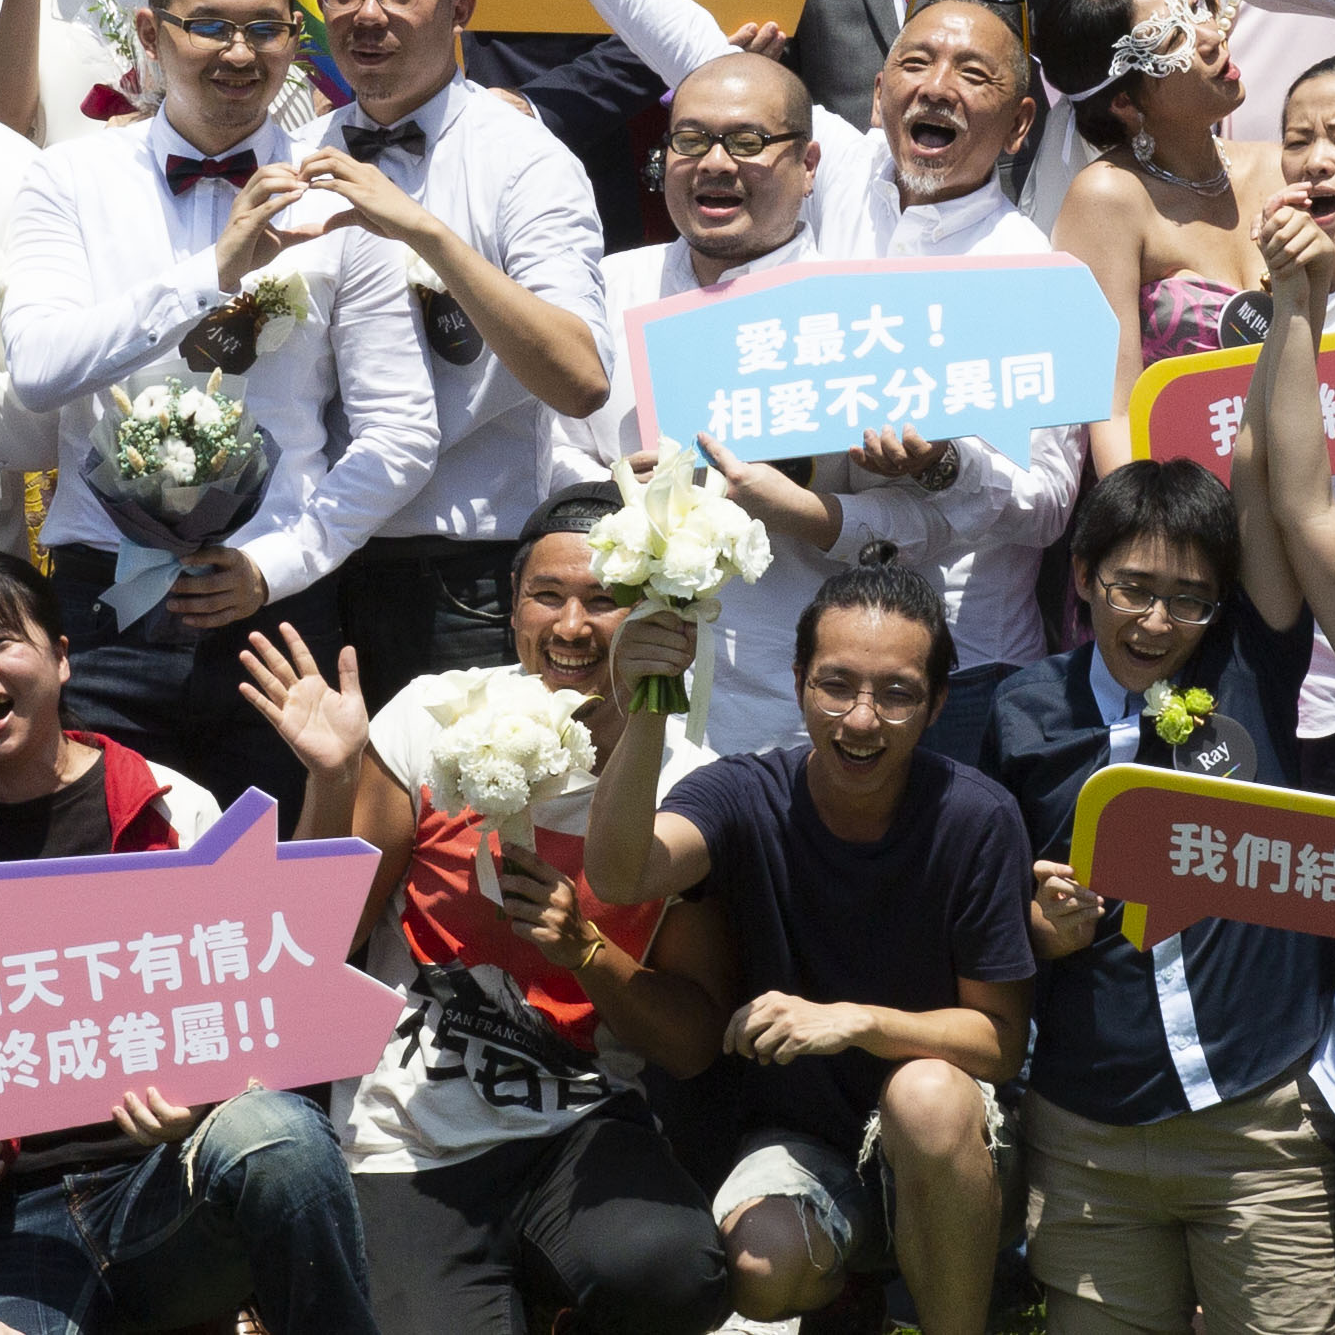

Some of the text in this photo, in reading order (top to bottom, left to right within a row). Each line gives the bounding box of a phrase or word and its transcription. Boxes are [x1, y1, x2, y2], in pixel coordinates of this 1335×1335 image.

[735, 303, 947, 375] 愛最大！
[707, 351, 1056, 442] 相愛不分異同
[1197, 741, 1230, 771] Ray
[445, 1009, 473, 1026] SAN
